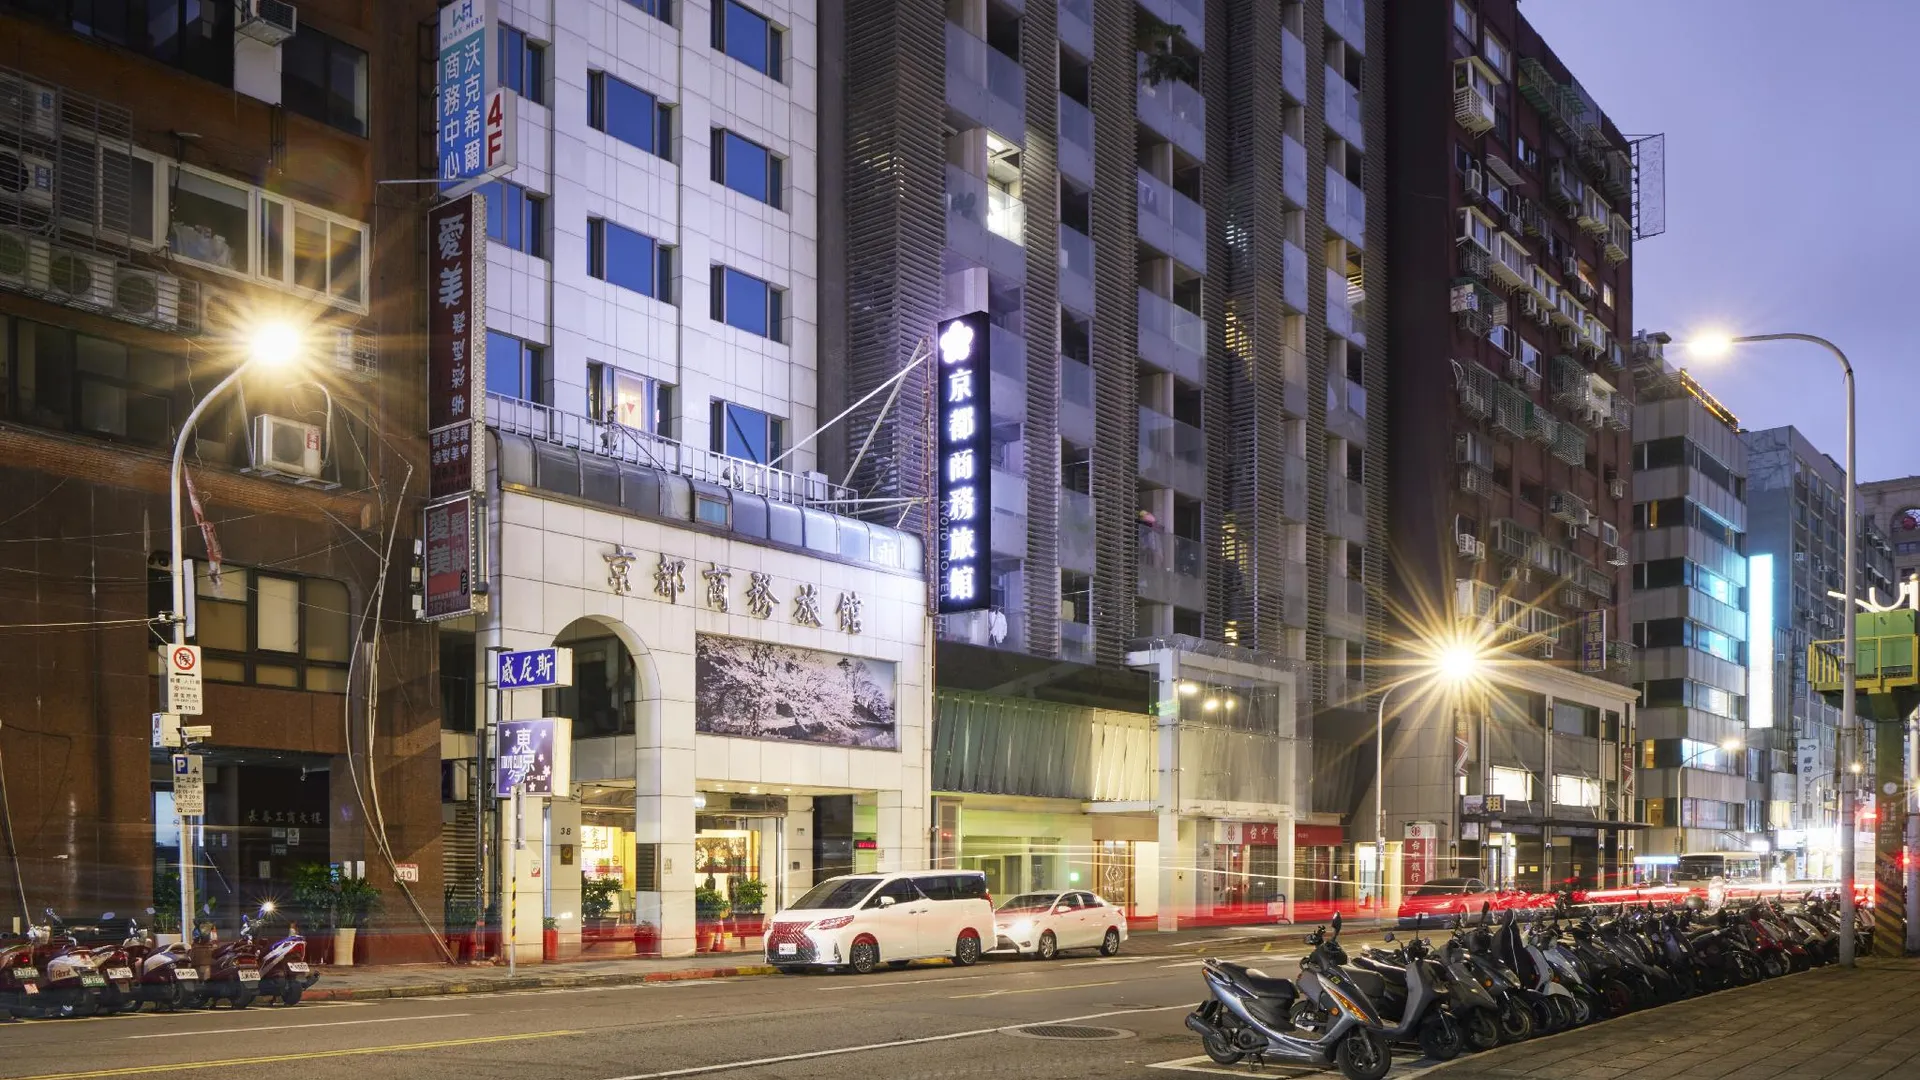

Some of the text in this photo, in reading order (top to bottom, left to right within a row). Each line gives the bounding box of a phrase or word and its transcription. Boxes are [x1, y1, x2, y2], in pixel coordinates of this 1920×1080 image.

[442, 16, 484, 43] WORK HERE
[444, 50, 461, 180] 商務中心
[464, 38, 481, 173] 沃克希爾
[438, 213, 465, 309] 愛美
[948, 369, 975, 600] 京都商務旅館
[429, 508, 450, 576] 愛美
[939, 500, 950, 602] KYOTO HOTEL
[603, 544, 865, 634] 京都商務旅館
[501, 653, 553, 685] 威尼斯
[515, 729, 536, 773] 東京
[560, 827, 572, 836] 38
[1486, 796, 1502, 811] 租
[1411, 841, 1421, 883] 台中銀行
